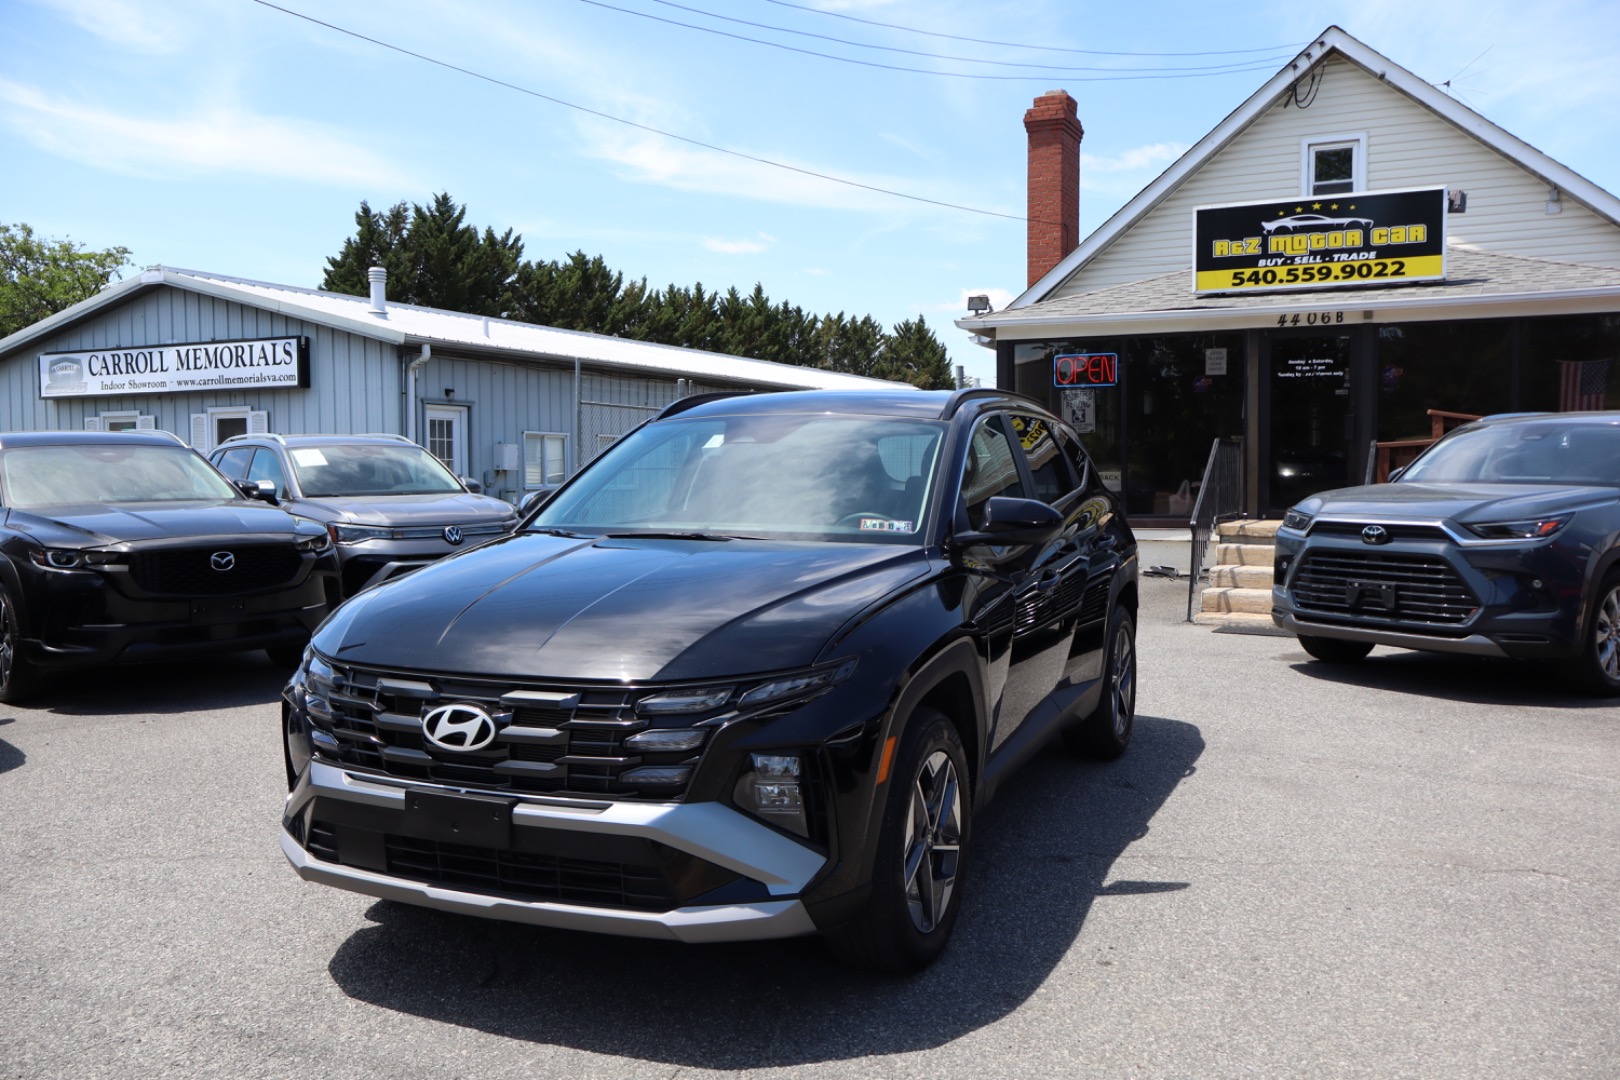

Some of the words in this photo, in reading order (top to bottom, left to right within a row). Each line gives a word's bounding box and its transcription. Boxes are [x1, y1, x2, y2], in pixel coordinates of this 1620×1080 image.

[1258, 258, 1285, 268] BUY
[1293, 254, 1323, 266] SELL
[1332, 251, 1377, 262] TRADE
[1231, 261, 1406, 286] 540.559.9022
[88, 350, 169, 377] CARROLL
[175, 341, 294, 372] MEMORIALS
[1057, 356, 1115, 384] OPEN
[100, 380, 126, 391] Indoor
[128, 378, 167, 390] Showroom
[176, 372, 297, 387] www.carrollmemorialsva.com
